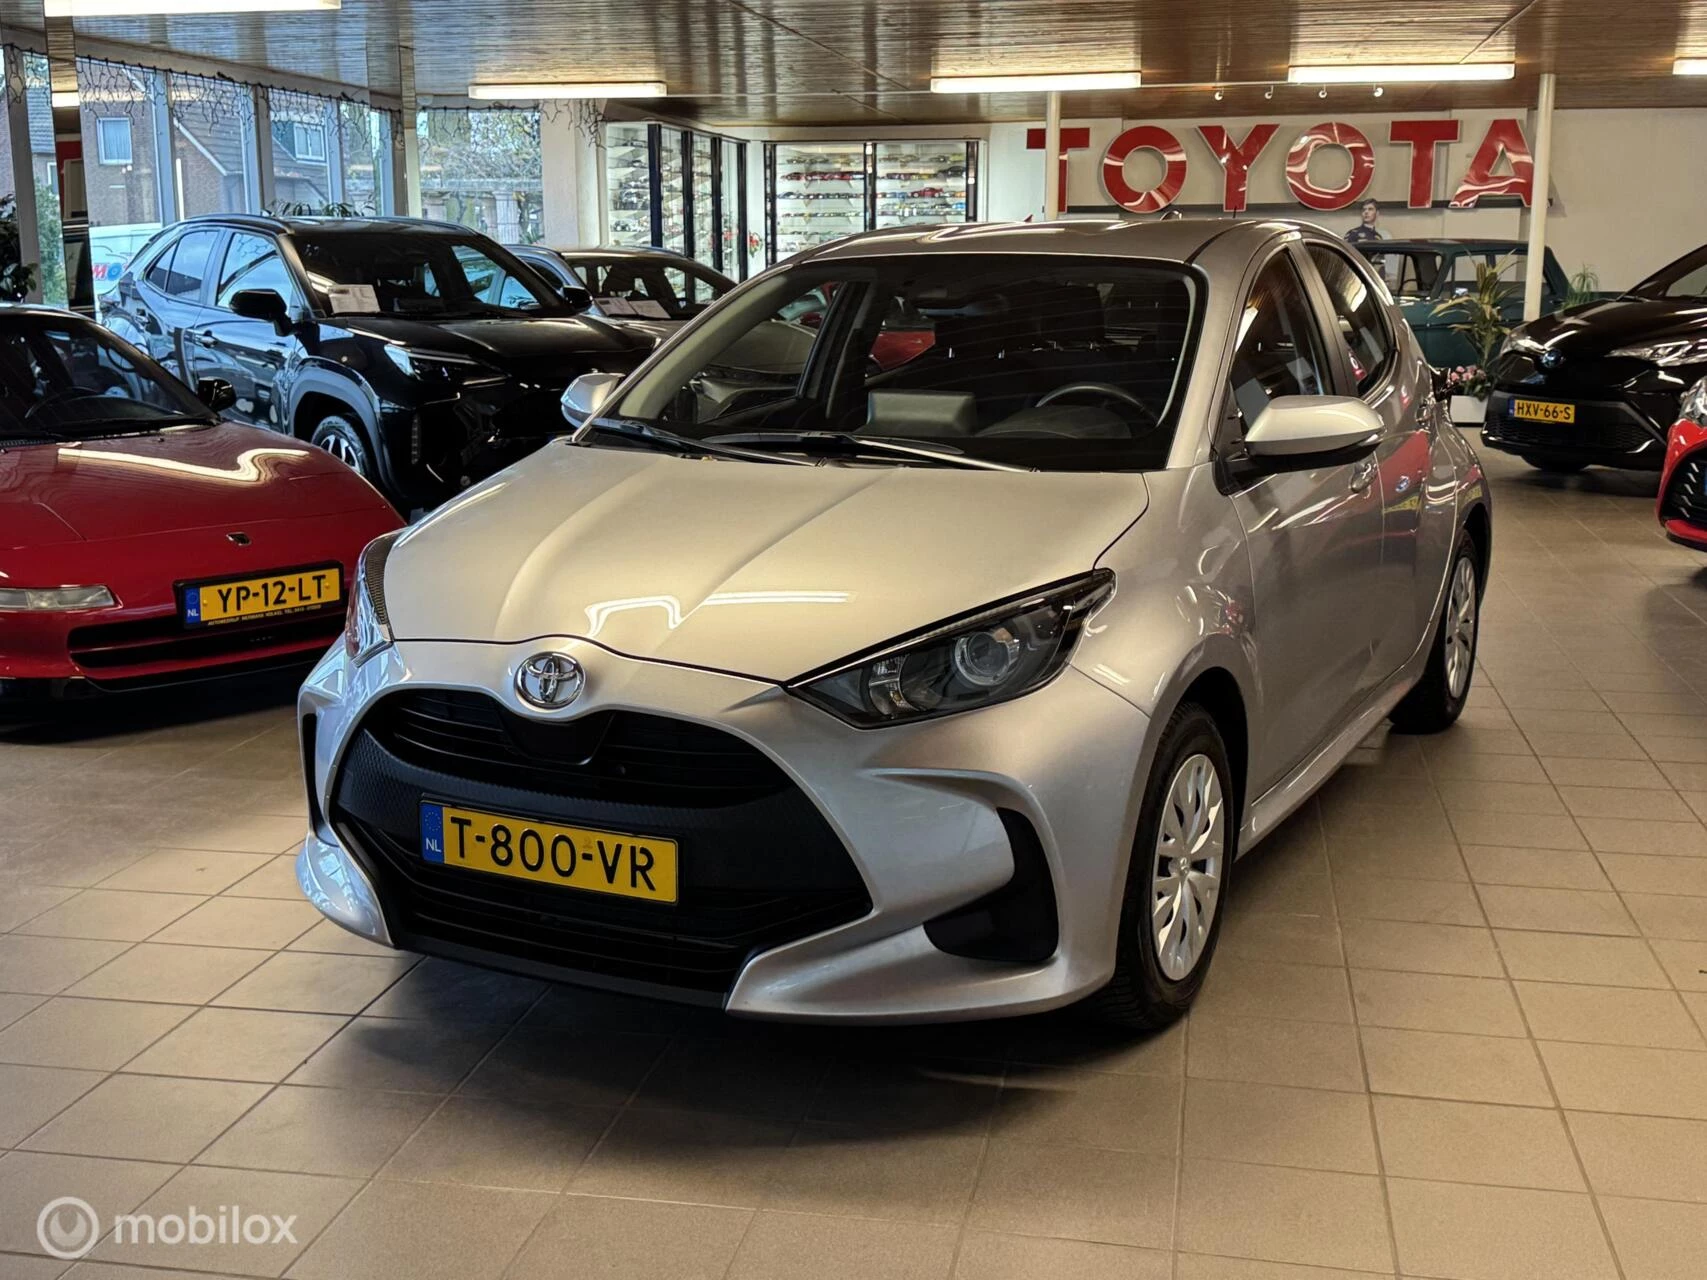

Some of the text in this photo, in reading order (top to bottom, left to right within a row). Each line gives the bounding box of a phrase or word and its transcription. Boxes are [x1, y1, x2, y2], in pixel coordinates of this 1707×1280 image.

[1026, 118, 1534, 214] TOYOTA
[1516, 402, 1571, 420] HXV-66-S
[217, 574, 327, 613] YP-12-LT
[187, 608, 199, 618] NL
[425, 837, 442, 853] NL
[450, 815, 657, 892] T-800-VR
